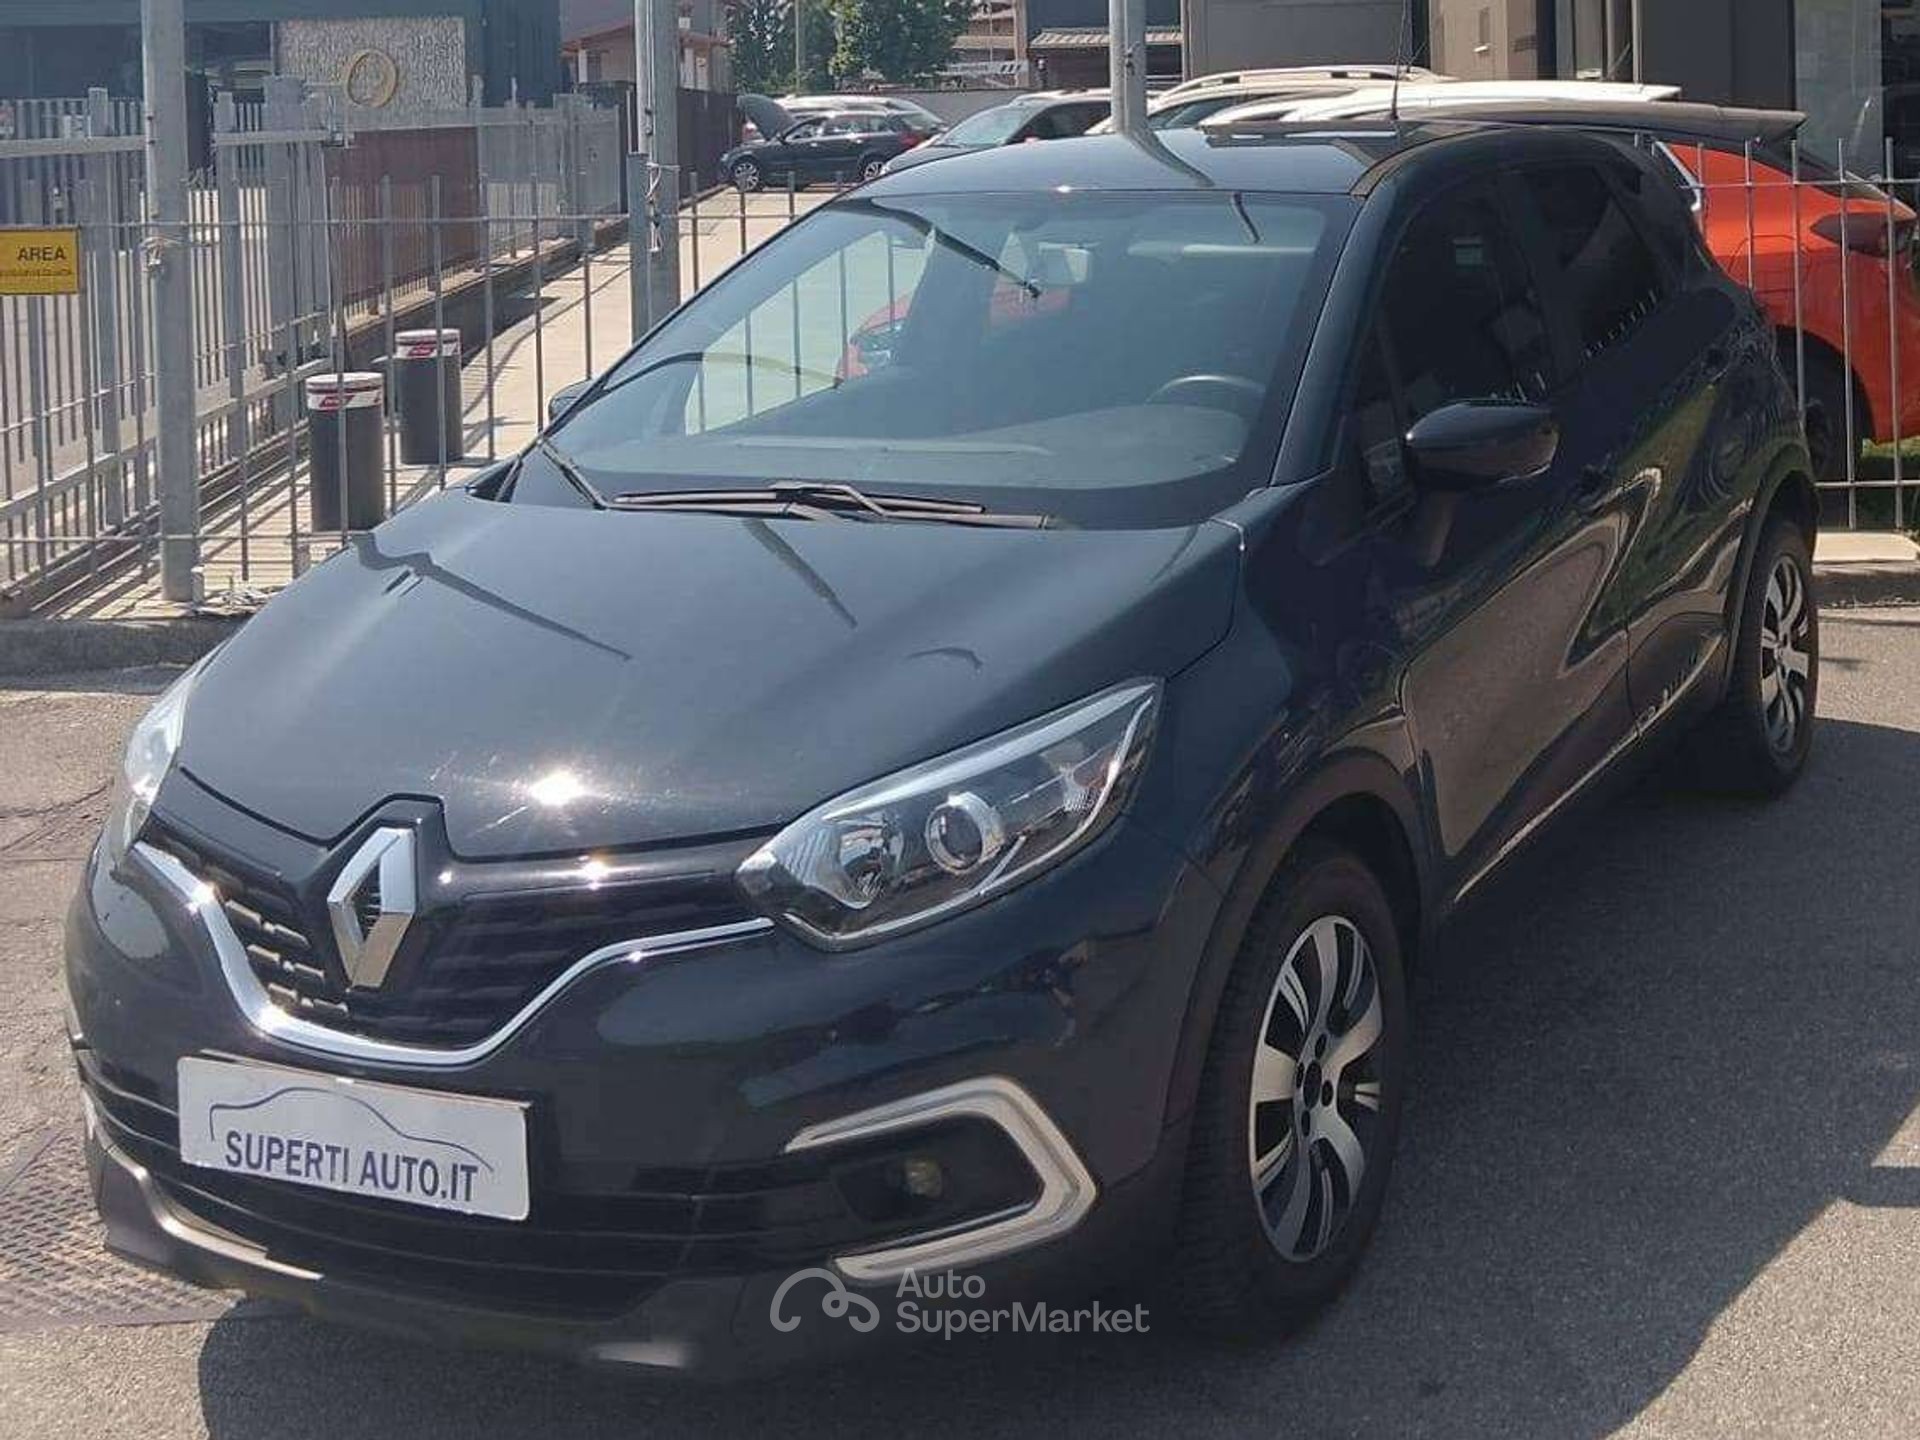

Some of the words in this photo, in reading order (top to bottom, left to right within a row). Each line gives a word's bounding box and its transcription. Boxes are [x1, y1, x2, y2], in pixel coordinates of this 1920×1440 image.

[17, 246, 67, 261] AREA
[225, 1130, 349, 1183] SUPERTI
[359, 1151, 478, 1202] AUTO.IT
